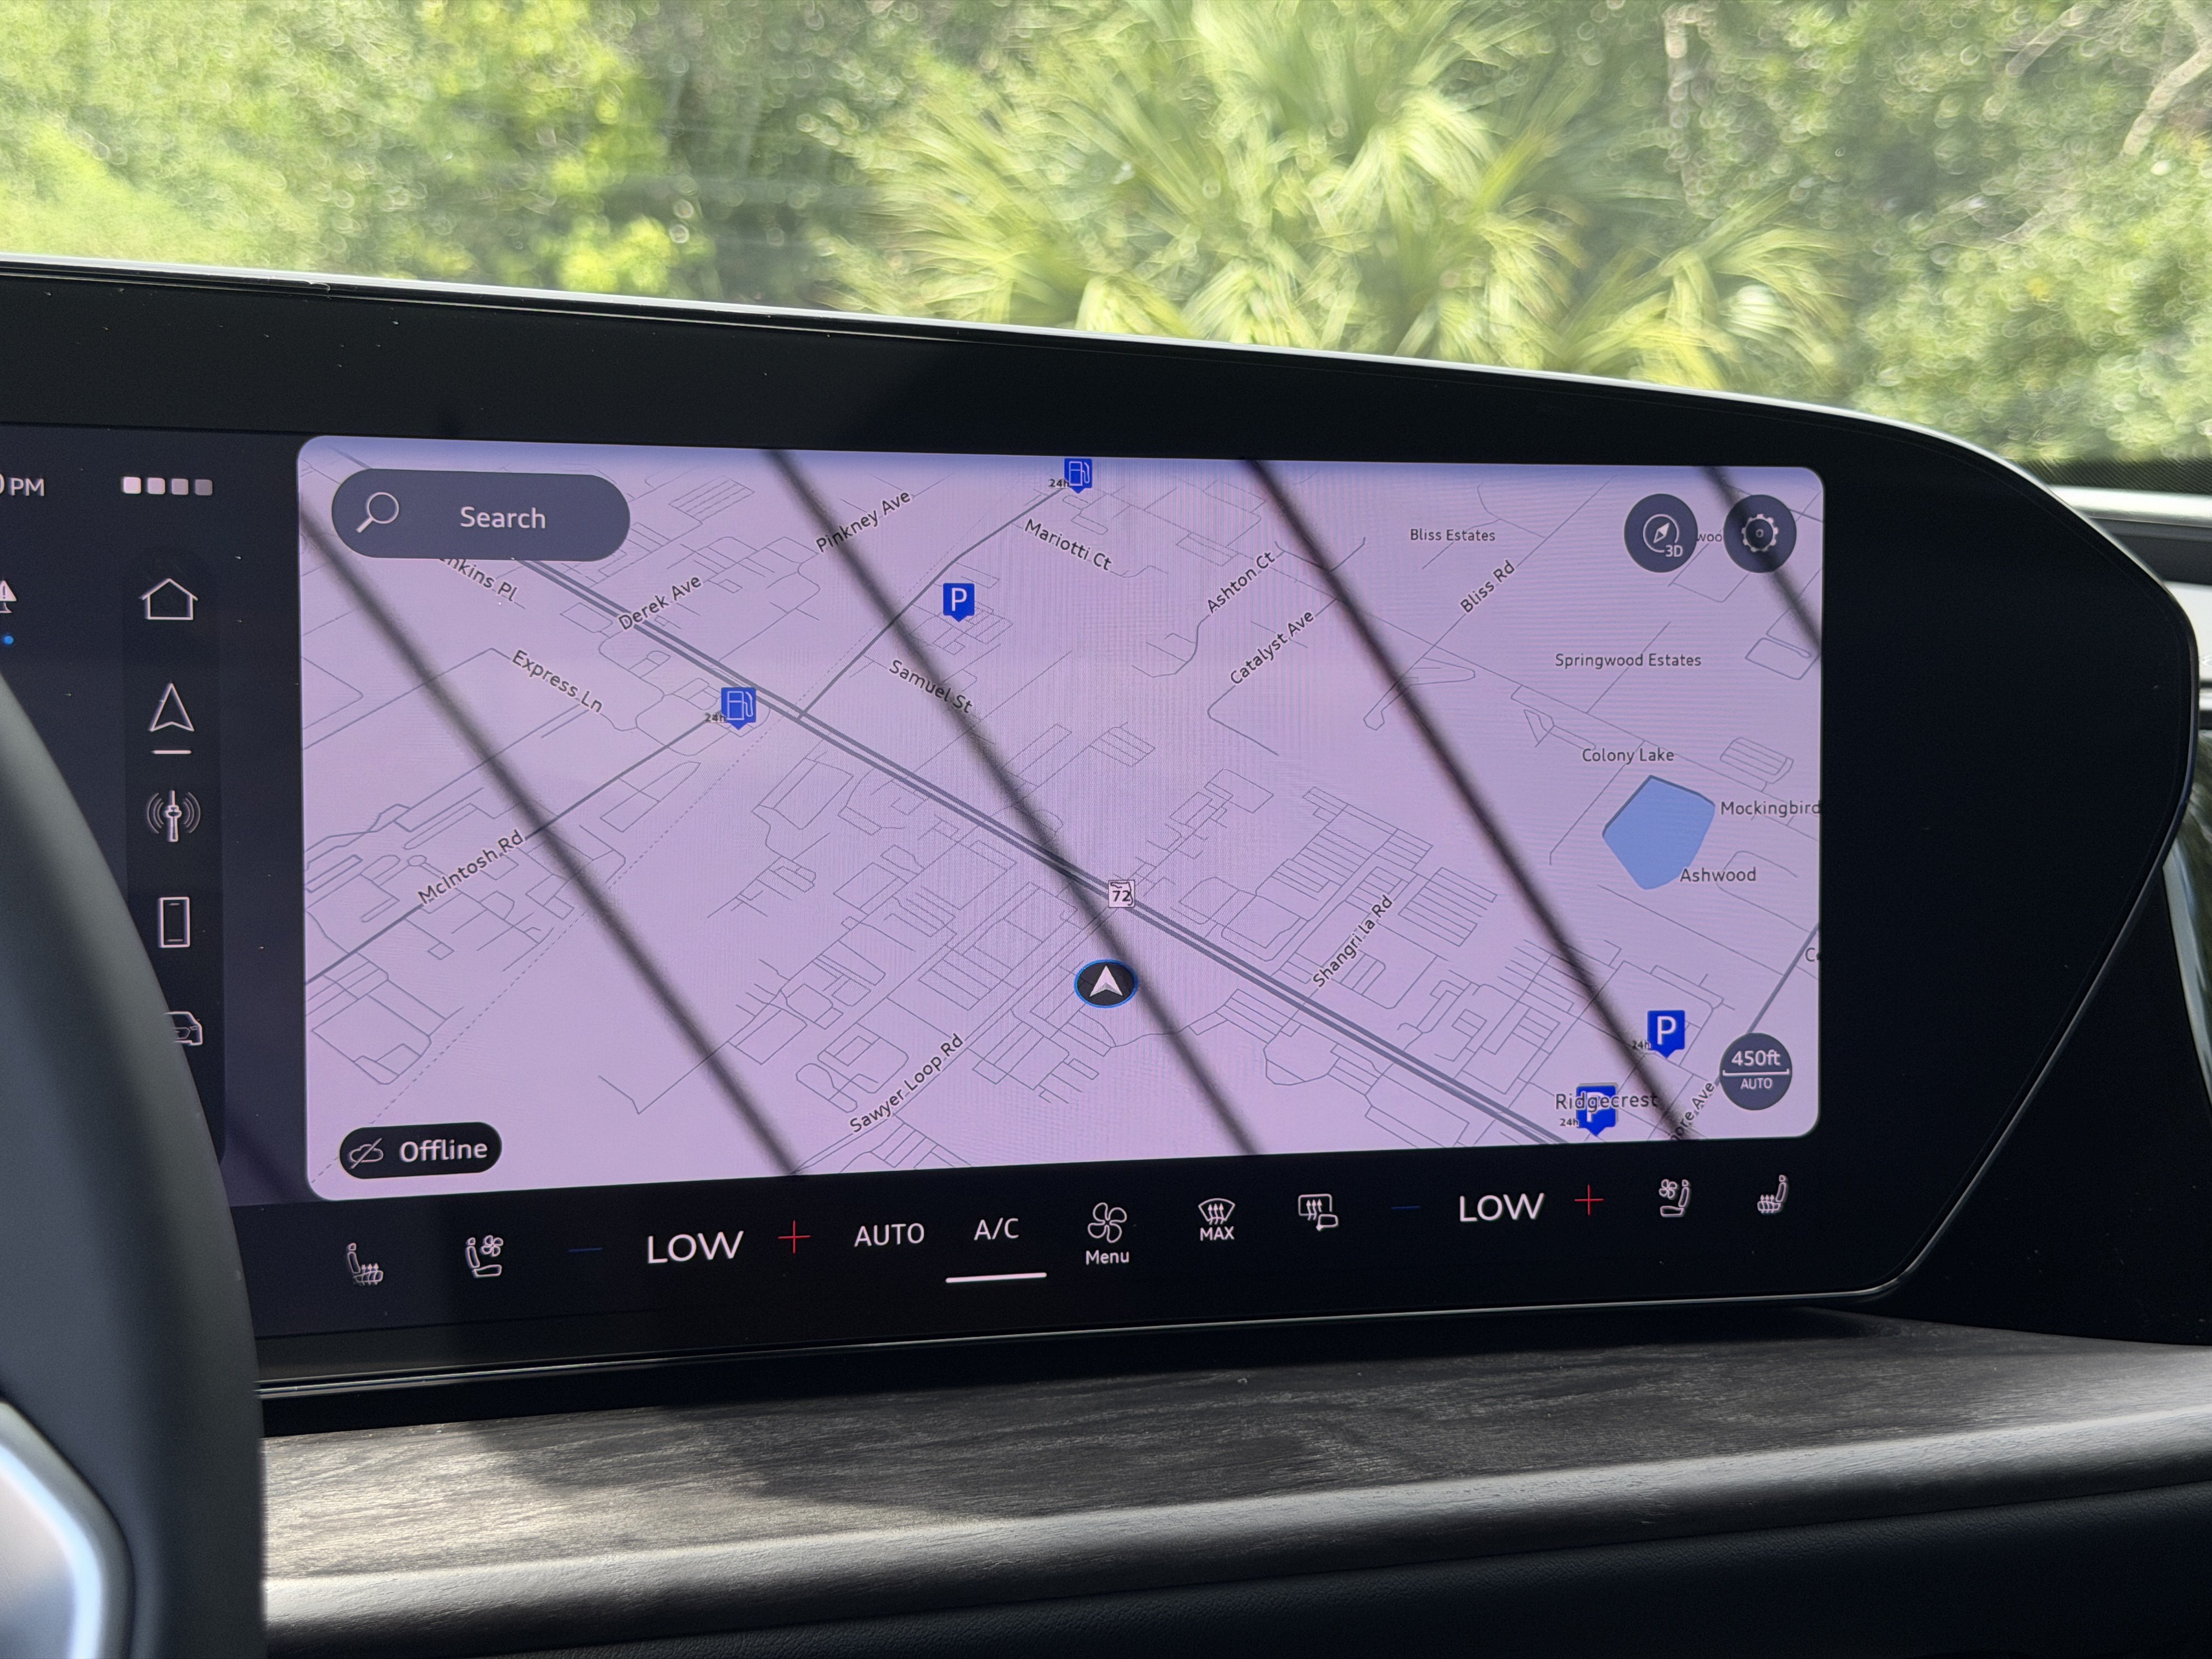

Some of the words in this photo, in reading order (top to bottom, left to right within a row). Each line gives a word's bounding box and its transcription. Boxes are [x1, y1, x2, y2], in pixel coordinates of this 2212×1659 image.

[10, 478, 44, 496] PM
[1048, 479, 1070, 488] 24h
[460, 506, 546, 529] Search
[816, 510, 879, 552] Pinkney
[881, 491, 911, 516] Ave
[1024, 519, 1091, 561] Mariotti
[1093, 552, 1113, 571] Ct
[1410, 528, 1442, 542] Bliss
[1445, 528, 1496, 542] Estates
[1664, 545, 1684, 557] 3D
[439, 558, 495, 589] nkins
[497, 582, 518, 602] Pl
[1207, 567, 1257, 613] Ashton
[1256, 551, 1276, 574] Ct
[1460, 579, 1496, 614] Bliss
[1493, 560, 1515, 584] Rd
[618, 594, 668, 630] Derek
[671, 577, 702, 601] Ave
[1230, 633, 1288, 685] Catalyst
[1288, 610, 1314, 638] Ave
[1555, 653, 1643, 669] Springwood
[1648, 653, 1702, 667] Estates
[512, 649, 578, 698] Express
[580, 690, 603, 713] Ln
[889, 659, 950, 703] Samuel
[951, 694, 973, 713] St
[1582, 748, 1635, 765] Colony
[1639, 747, 1674, 762] Lake
[1720, 800, 1821, 818] Mockingbird
[417, 850, 499, 905] McIntosh
[498, 829, 525, 857] Rd
[1680, 866, 1757, 883] Ashwood
[1111, 890, 1131, 903] 72
[1312, 933, 1363, 988] Shangri
[1358, 918, 1375, 935] la
[1372, 894, 1393, 918] Rd
[1804, 947, 1821, 963] C
[1731, 1049, 1781, 1066] 450ft
[849, 1088, 906, 1133] Sawyer
[905, 1054, 943, 1094] Loop
[940, 1033, 964, 1060] Rd
[1740, 1077, 1773, 1090] AUTO
[1555, 1092, 1658, 1111] Ridgecrest
[1691, 1081, 1715, 1109] Ave
[1559, 1118, 1579, 1127] 24h
[399, 1139, 488, 1163] Offline
[1459, 1192, 1544, 1222] LOW
[854, 1223, 925, 1248] AUTO
[973, 1218, 1020, 1241] A/C
[1199, 1226, 1234, 1242] MAX
[647, 1231, 744, 1264] LOW
[1085, 1249, 1130, 1266] Menu
